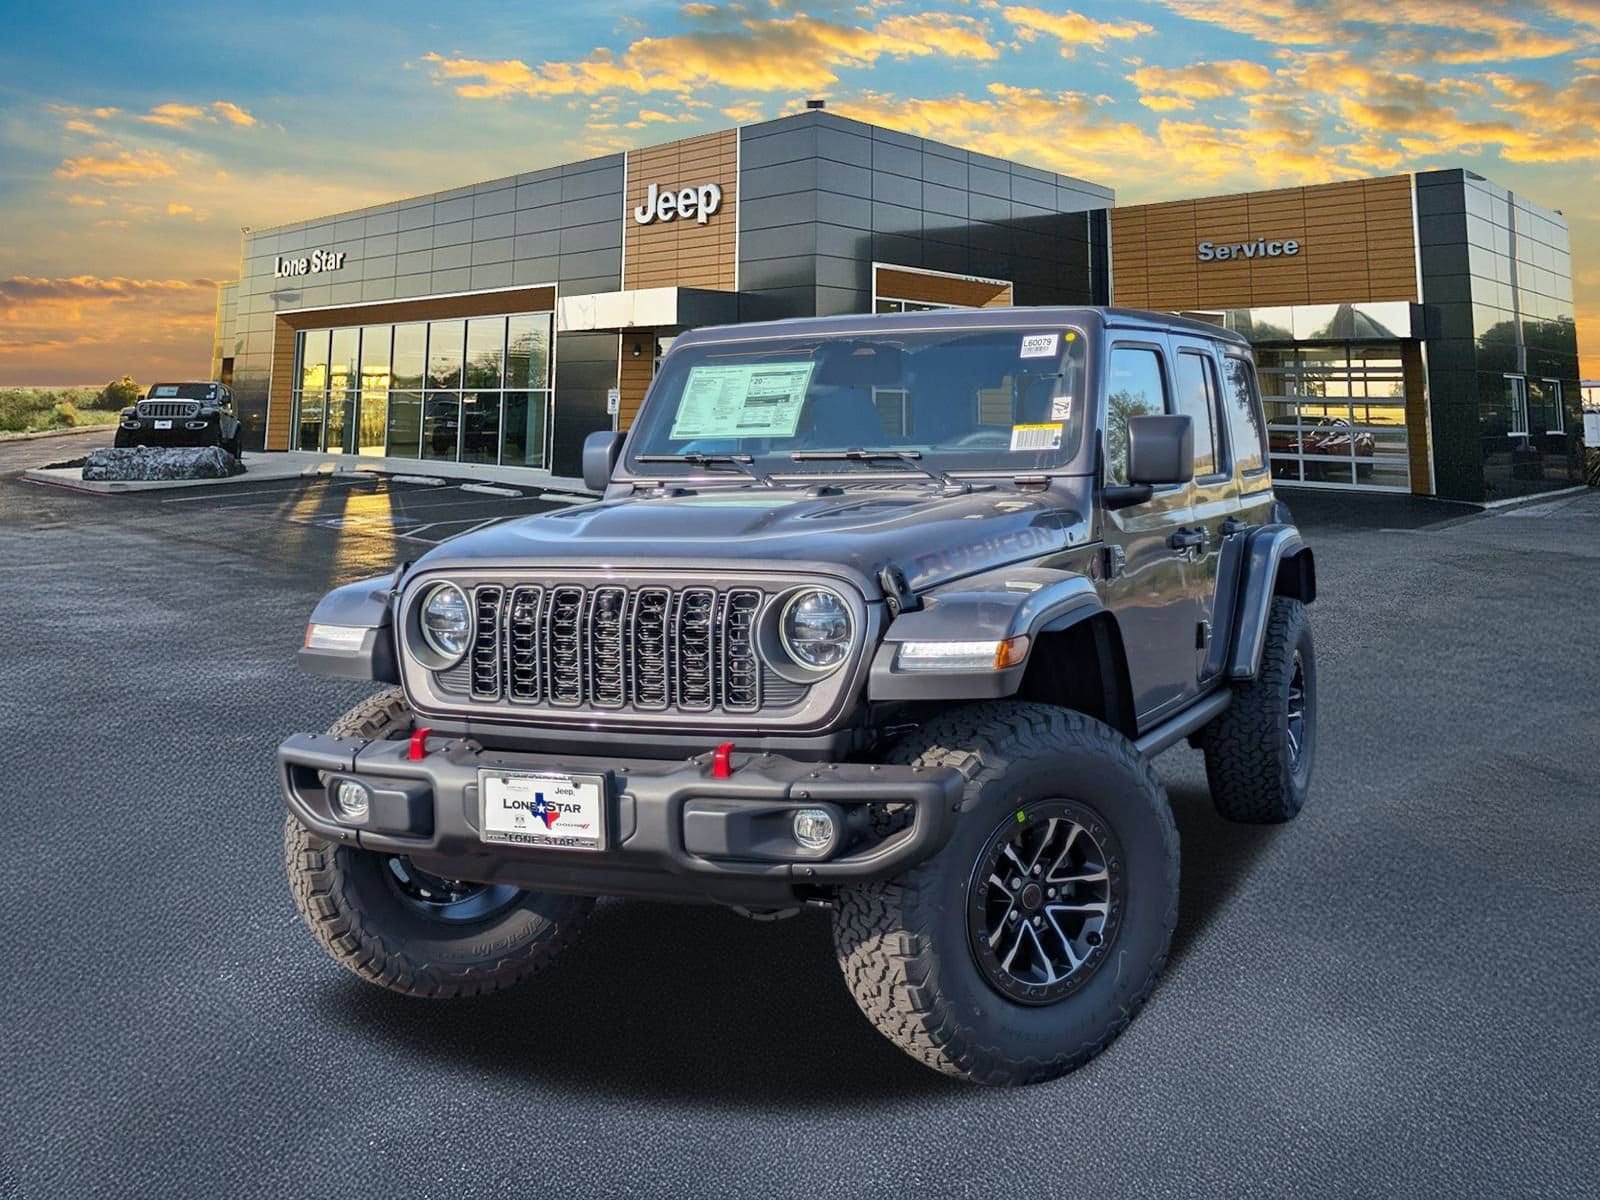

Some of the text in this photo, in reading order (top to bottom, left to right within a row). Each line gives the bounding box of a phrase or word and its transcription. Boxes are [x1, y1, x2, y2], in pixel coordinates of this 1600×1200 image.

[634, 183, 722, 224] Jeep
[1198, 236, 1299, 261] Service
[275, 249, 346, 278] Lone Star
[555, 787, 574, 797] Jeep
[503, 798, 581, 813] LONE STAR
[509, 834, 540, 844] LONE
[544, 836, 575, 846] STAR
